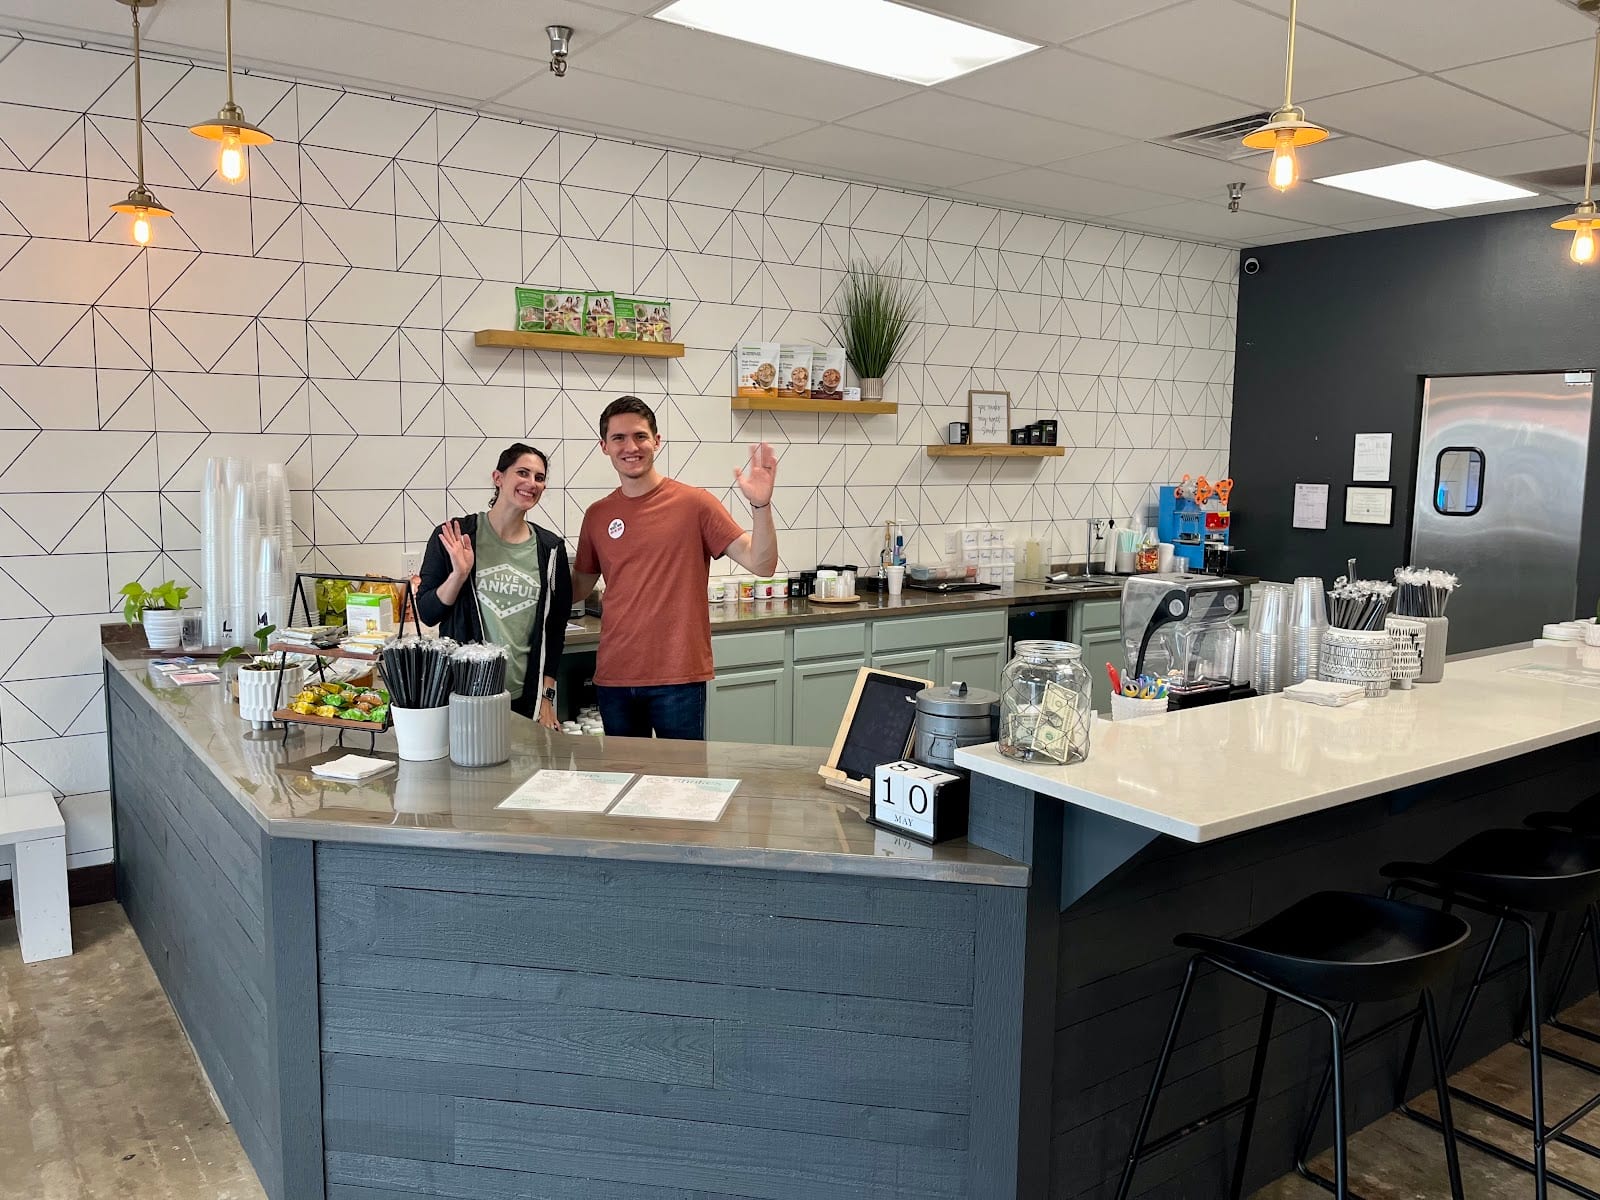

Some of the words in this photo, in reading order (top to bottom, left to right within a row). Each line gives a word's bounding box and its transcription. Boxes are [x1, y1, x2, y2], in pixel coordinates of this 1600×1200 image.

[494, 573, 520, 584] LIVE
[223, 620, 233, 633] L
[894, 813, 914, 827] MAY
